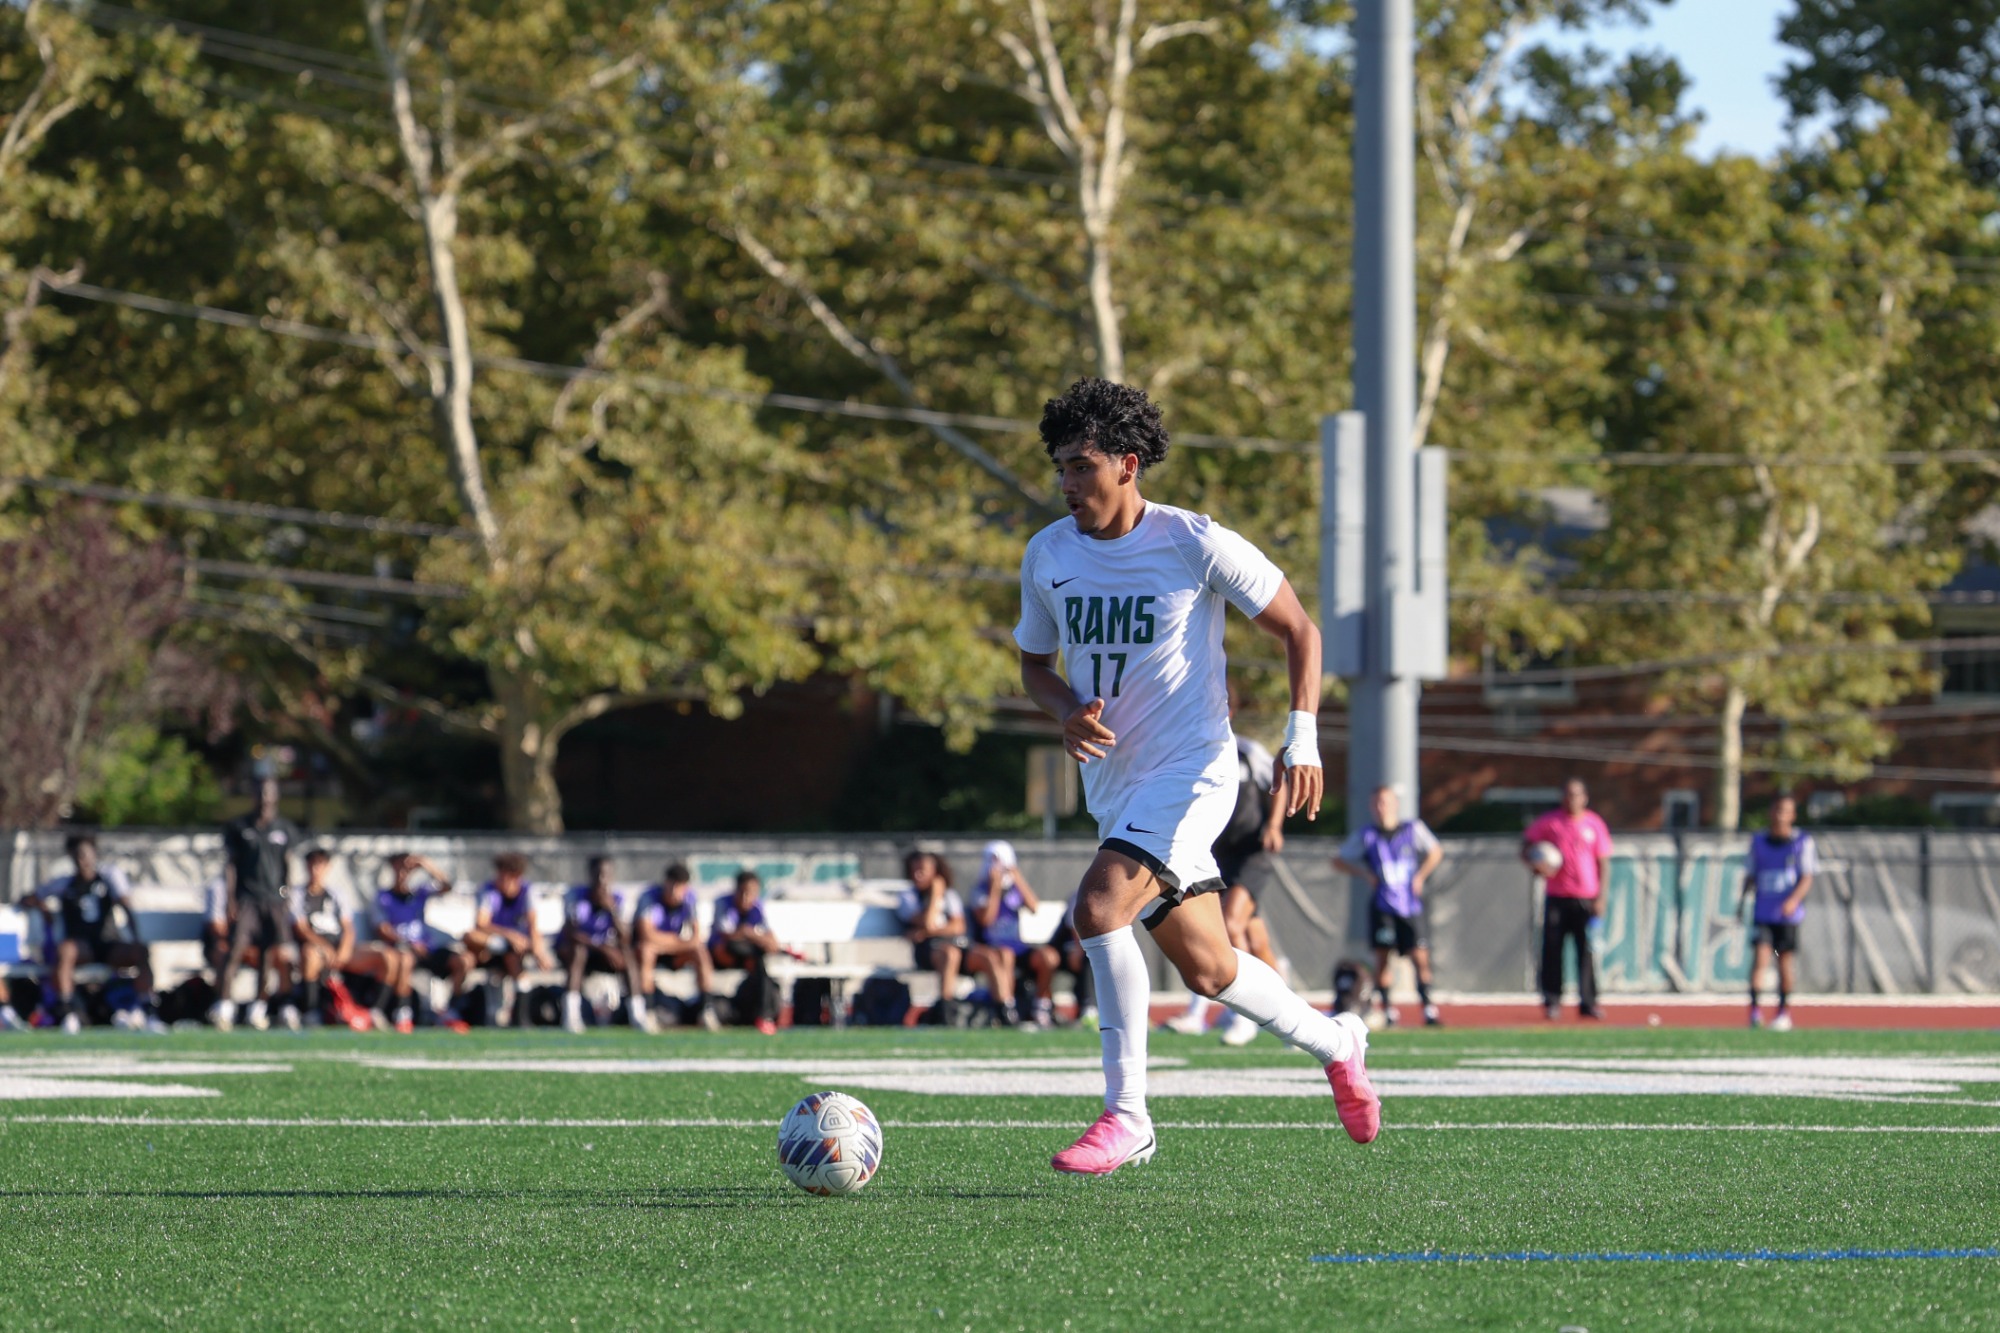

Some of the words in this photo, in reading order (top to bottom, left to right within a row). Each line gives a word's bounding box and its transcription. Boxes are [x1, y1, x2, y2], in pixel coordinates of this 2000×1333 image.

[1064, 595, 1156, 645] RAMS
[1090, 652, 1127, 698] 17
[1545, 850, 1754, 985] AMS
